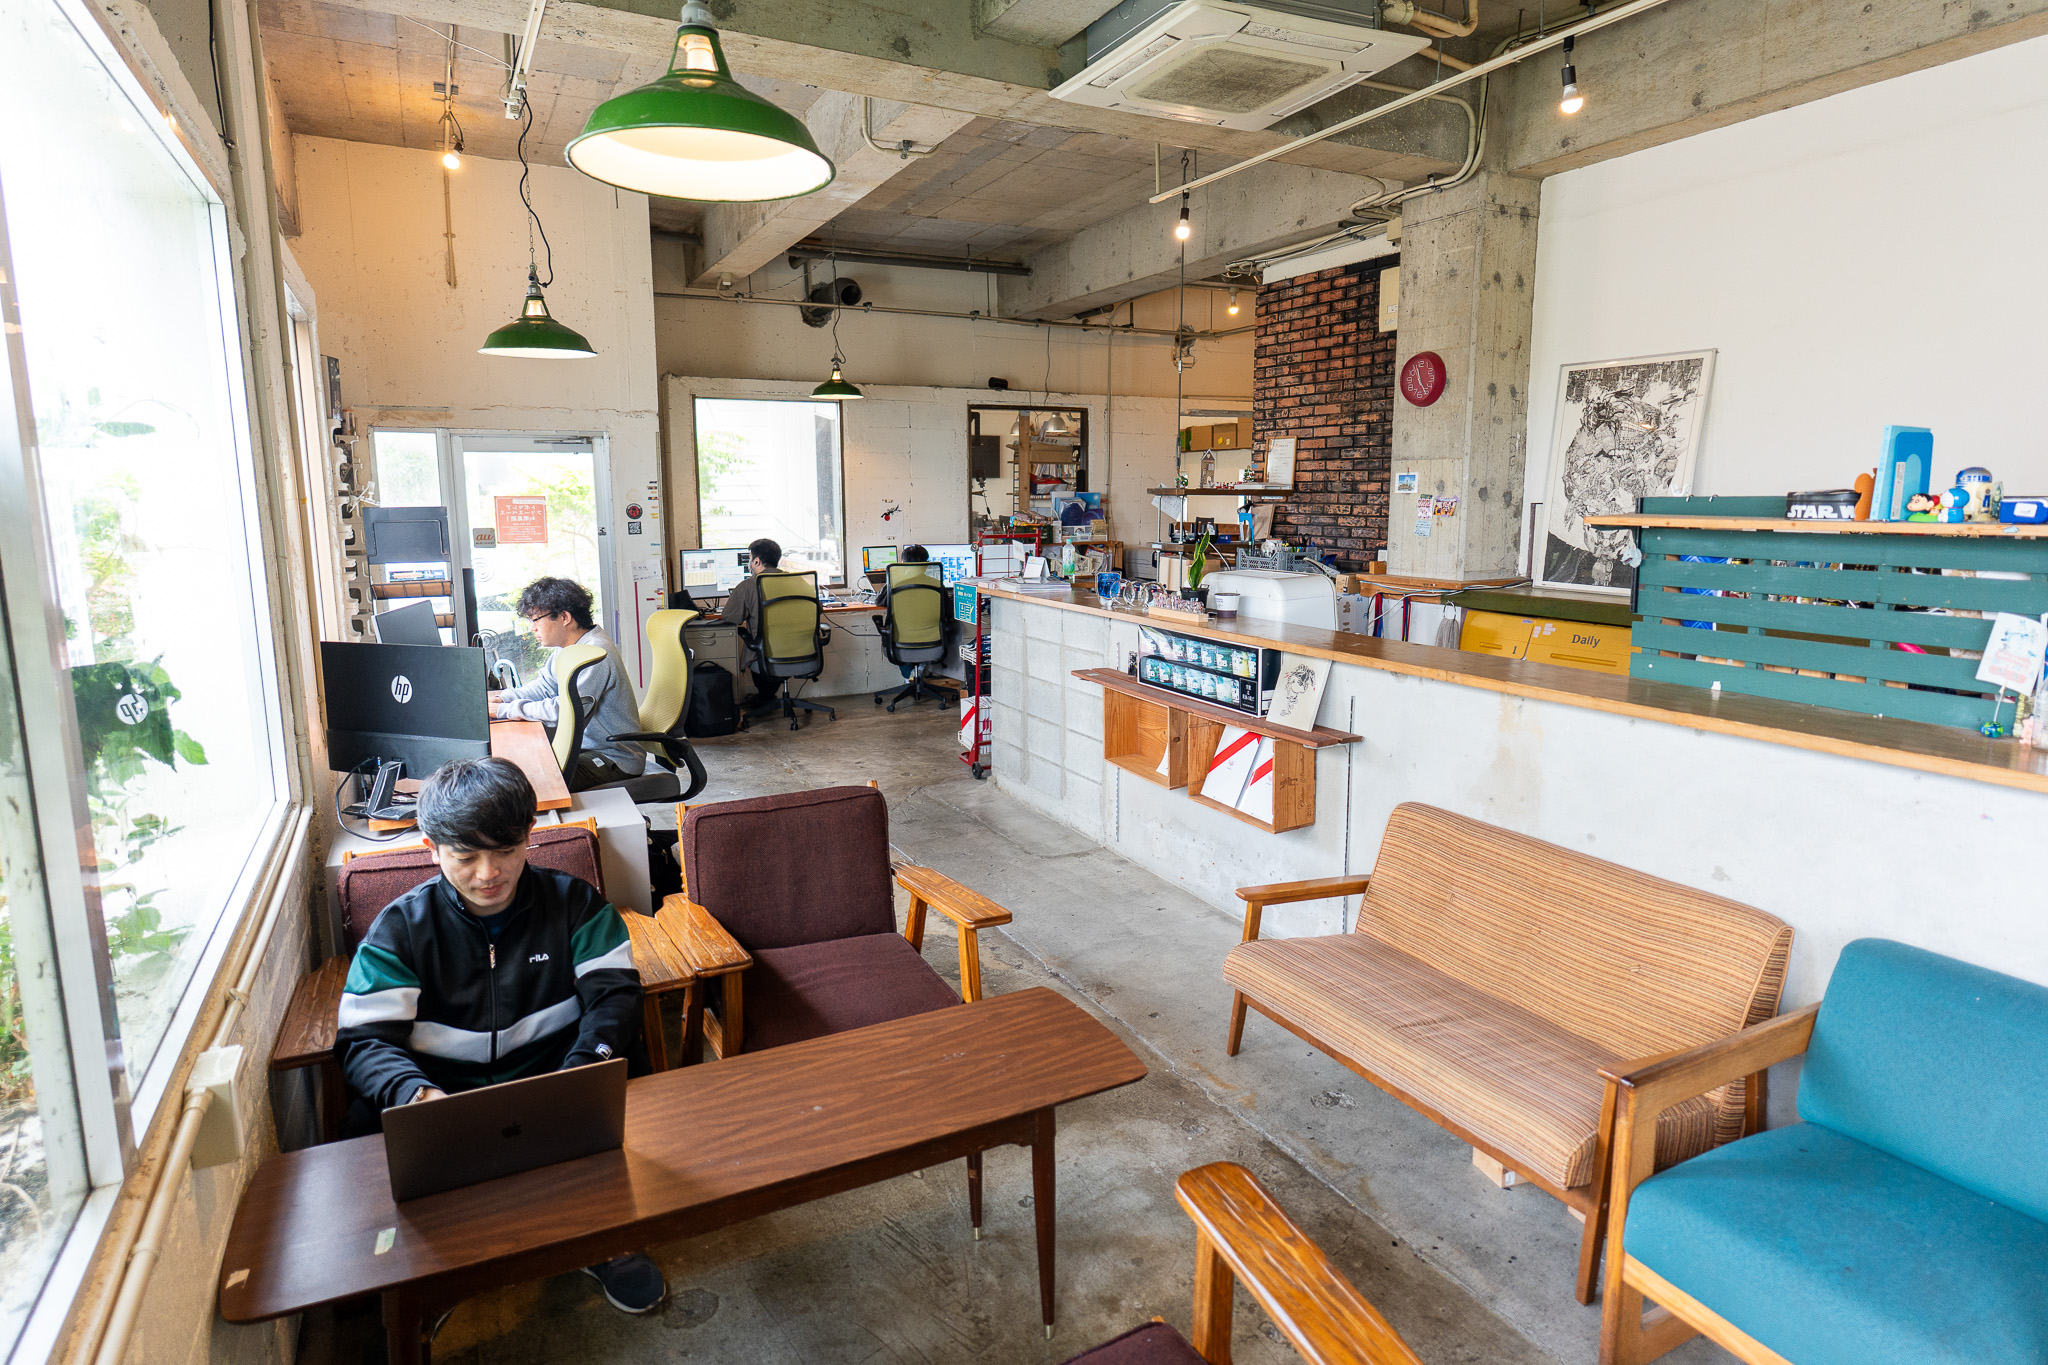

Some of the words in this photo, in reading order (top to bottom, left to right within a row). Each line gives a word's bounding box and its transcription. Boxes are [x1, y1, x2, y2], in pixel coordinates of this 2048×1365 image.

[1787, 505, 1838, 518] STAR
[1839, 505, 1857, 518] W
[1572, 634, 1600, 648] Daily
[395, 675, 410, 704] hp
[529, 953, 550, 964] FILA
